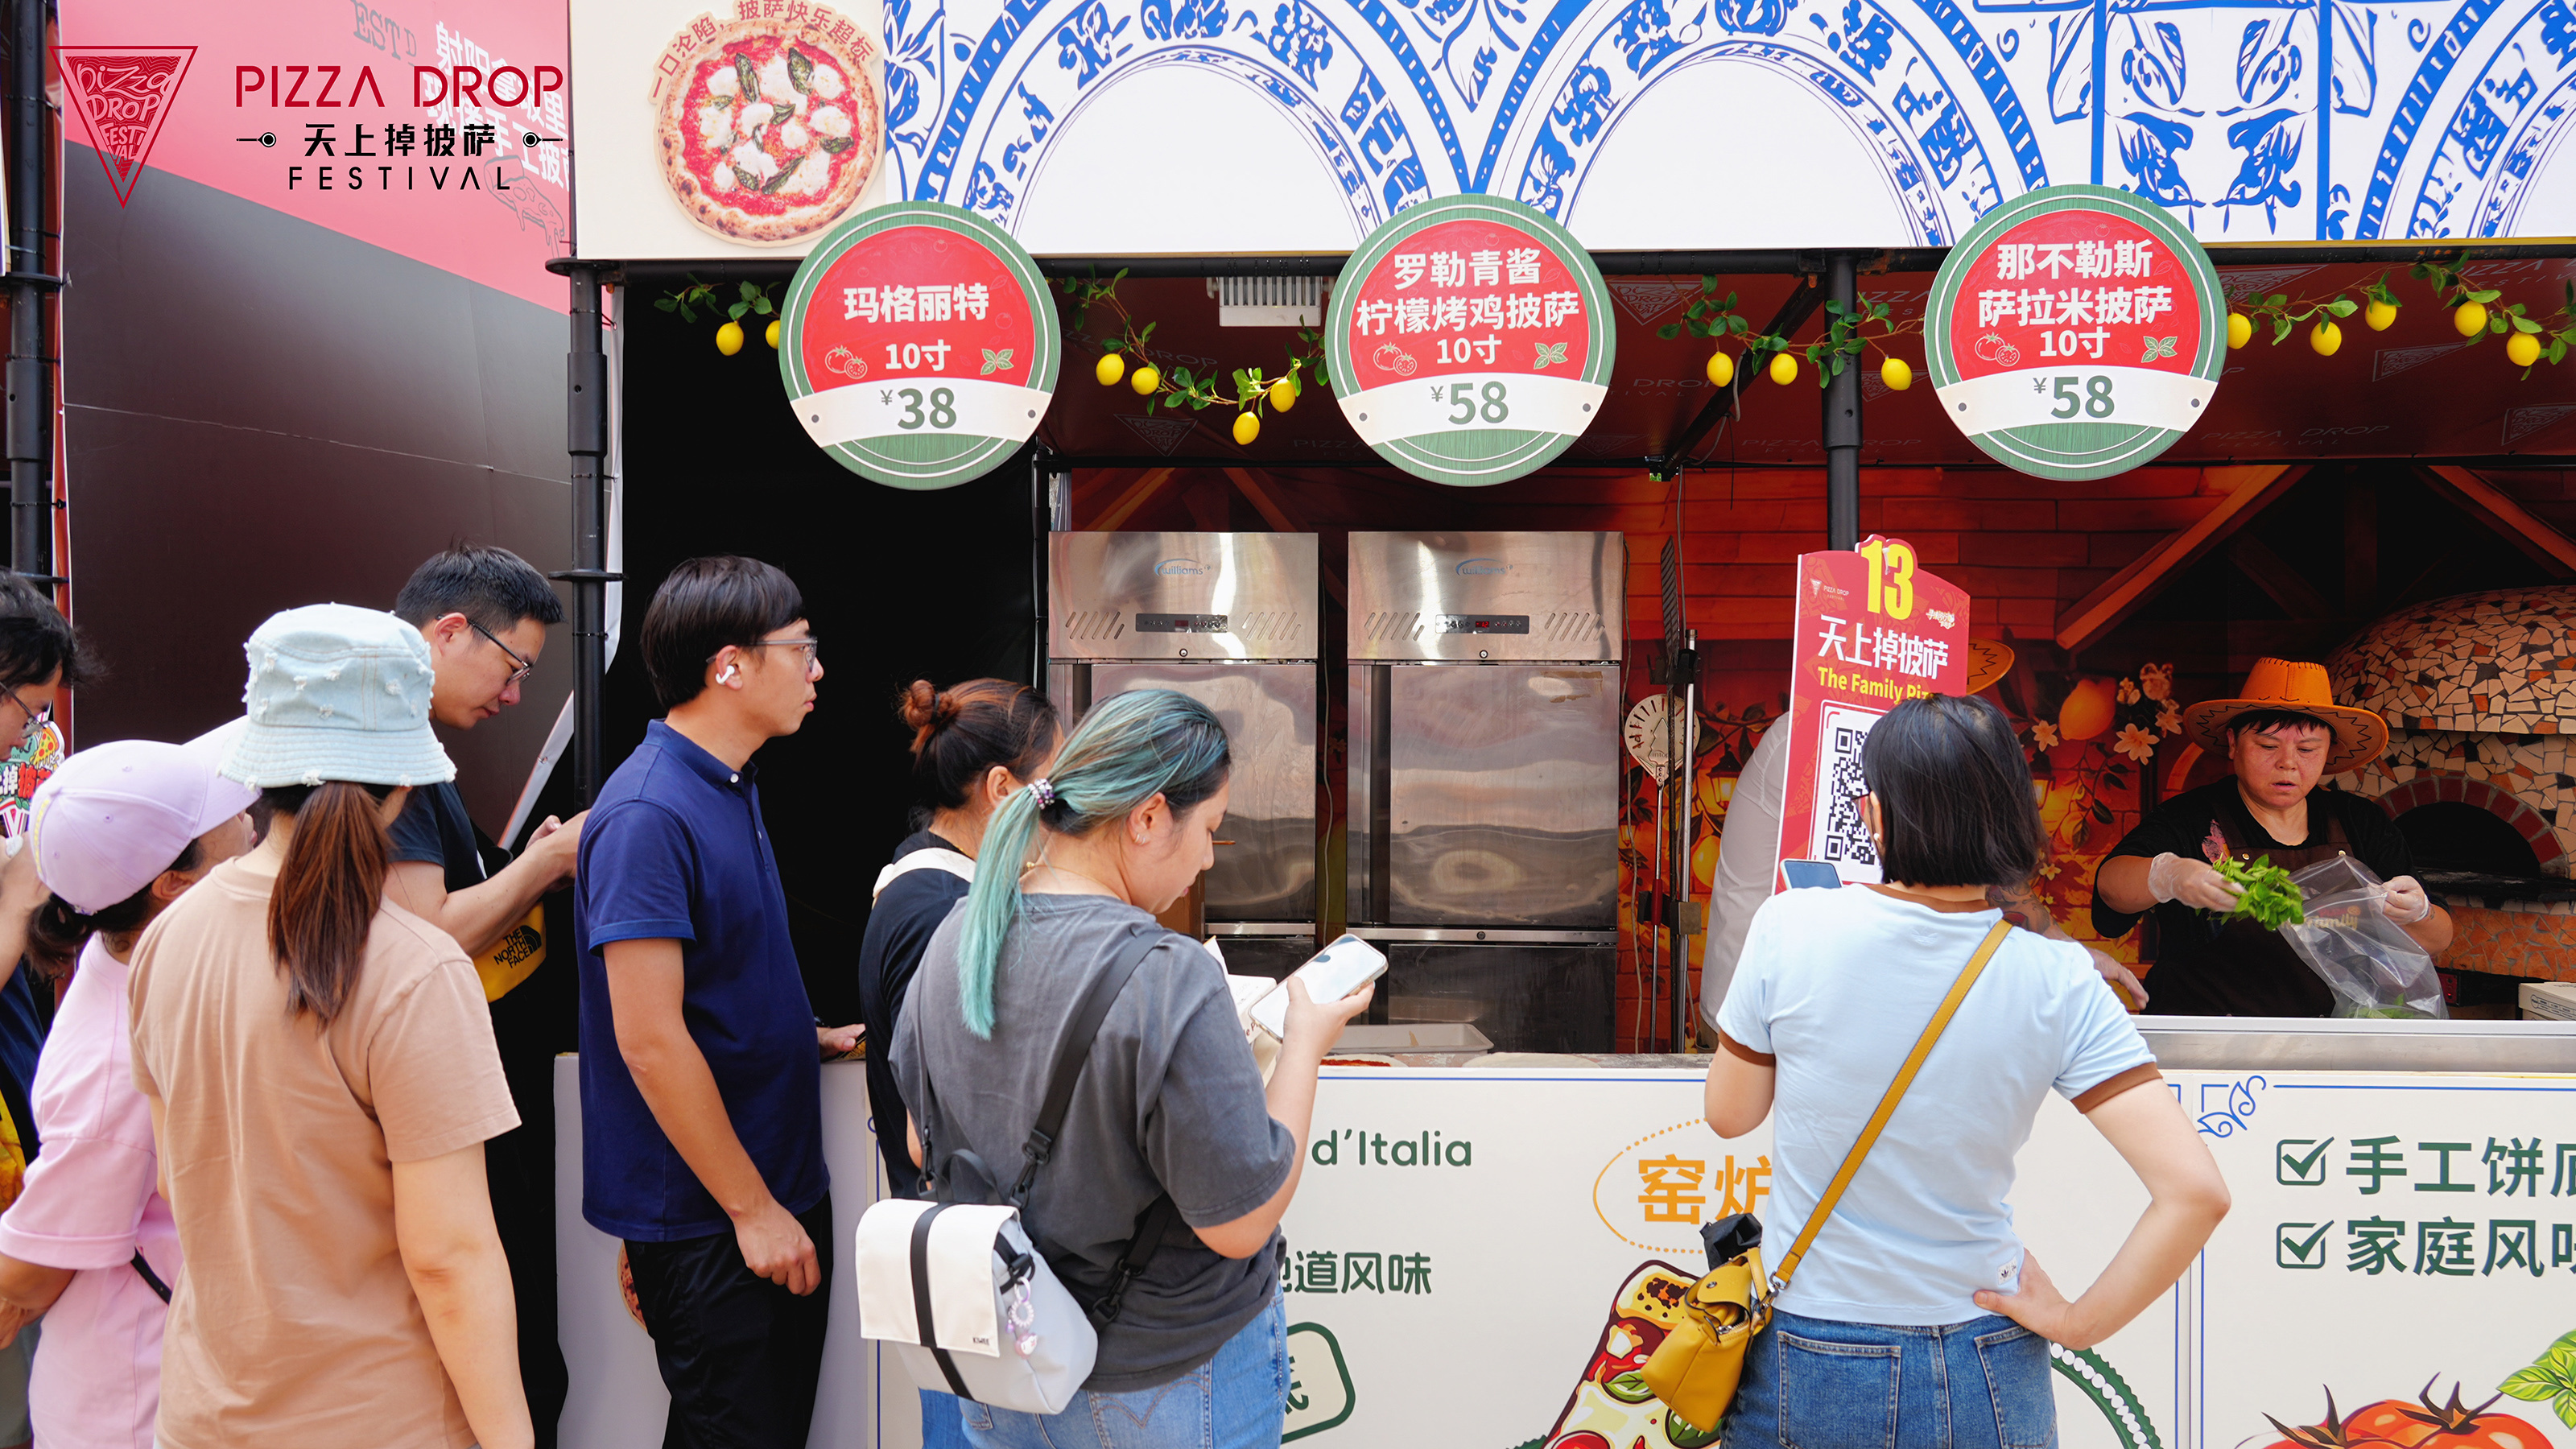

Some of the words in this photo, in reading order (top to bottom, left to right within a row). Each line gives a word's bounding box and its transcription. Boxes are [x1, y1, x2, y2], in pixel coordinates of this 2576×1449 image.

[1393, 247, 1542, 291] 罗勒青酱
[1996, 238, 2153, 281] 那不勒斯
[843, 282, 990, 324] 玛格丽特
[1356, 291, 1580, 336] 柠檬烤鸡披萨
[1977, 285, 2173, 328] 萨拉米披萨
[885, 339, 952, 373] 10寸
[1436, 333, 1503, 365] 10寸
[2039, 325, 2112, 360] 10寸
[880, 386, 957, 431] ¥38
[1430, 380, 1509, 425] ¥58
[2033, 374, 2116, 420] ¥58
[1161, 565, 1203, 576] williams
[1860, 539, 1914, 621] 13
[1818, 613, 1949, 680] 天上掉披萨
[1818, 666, 1847, 691] The
[1852, 673, 1903, 705] Family
[1907, 684, 1934, 700] Piz
[493, 937, 528, 965] NORTH
[502, 928, 522, 946] THE
[508, 947, 530, 968] FACE
